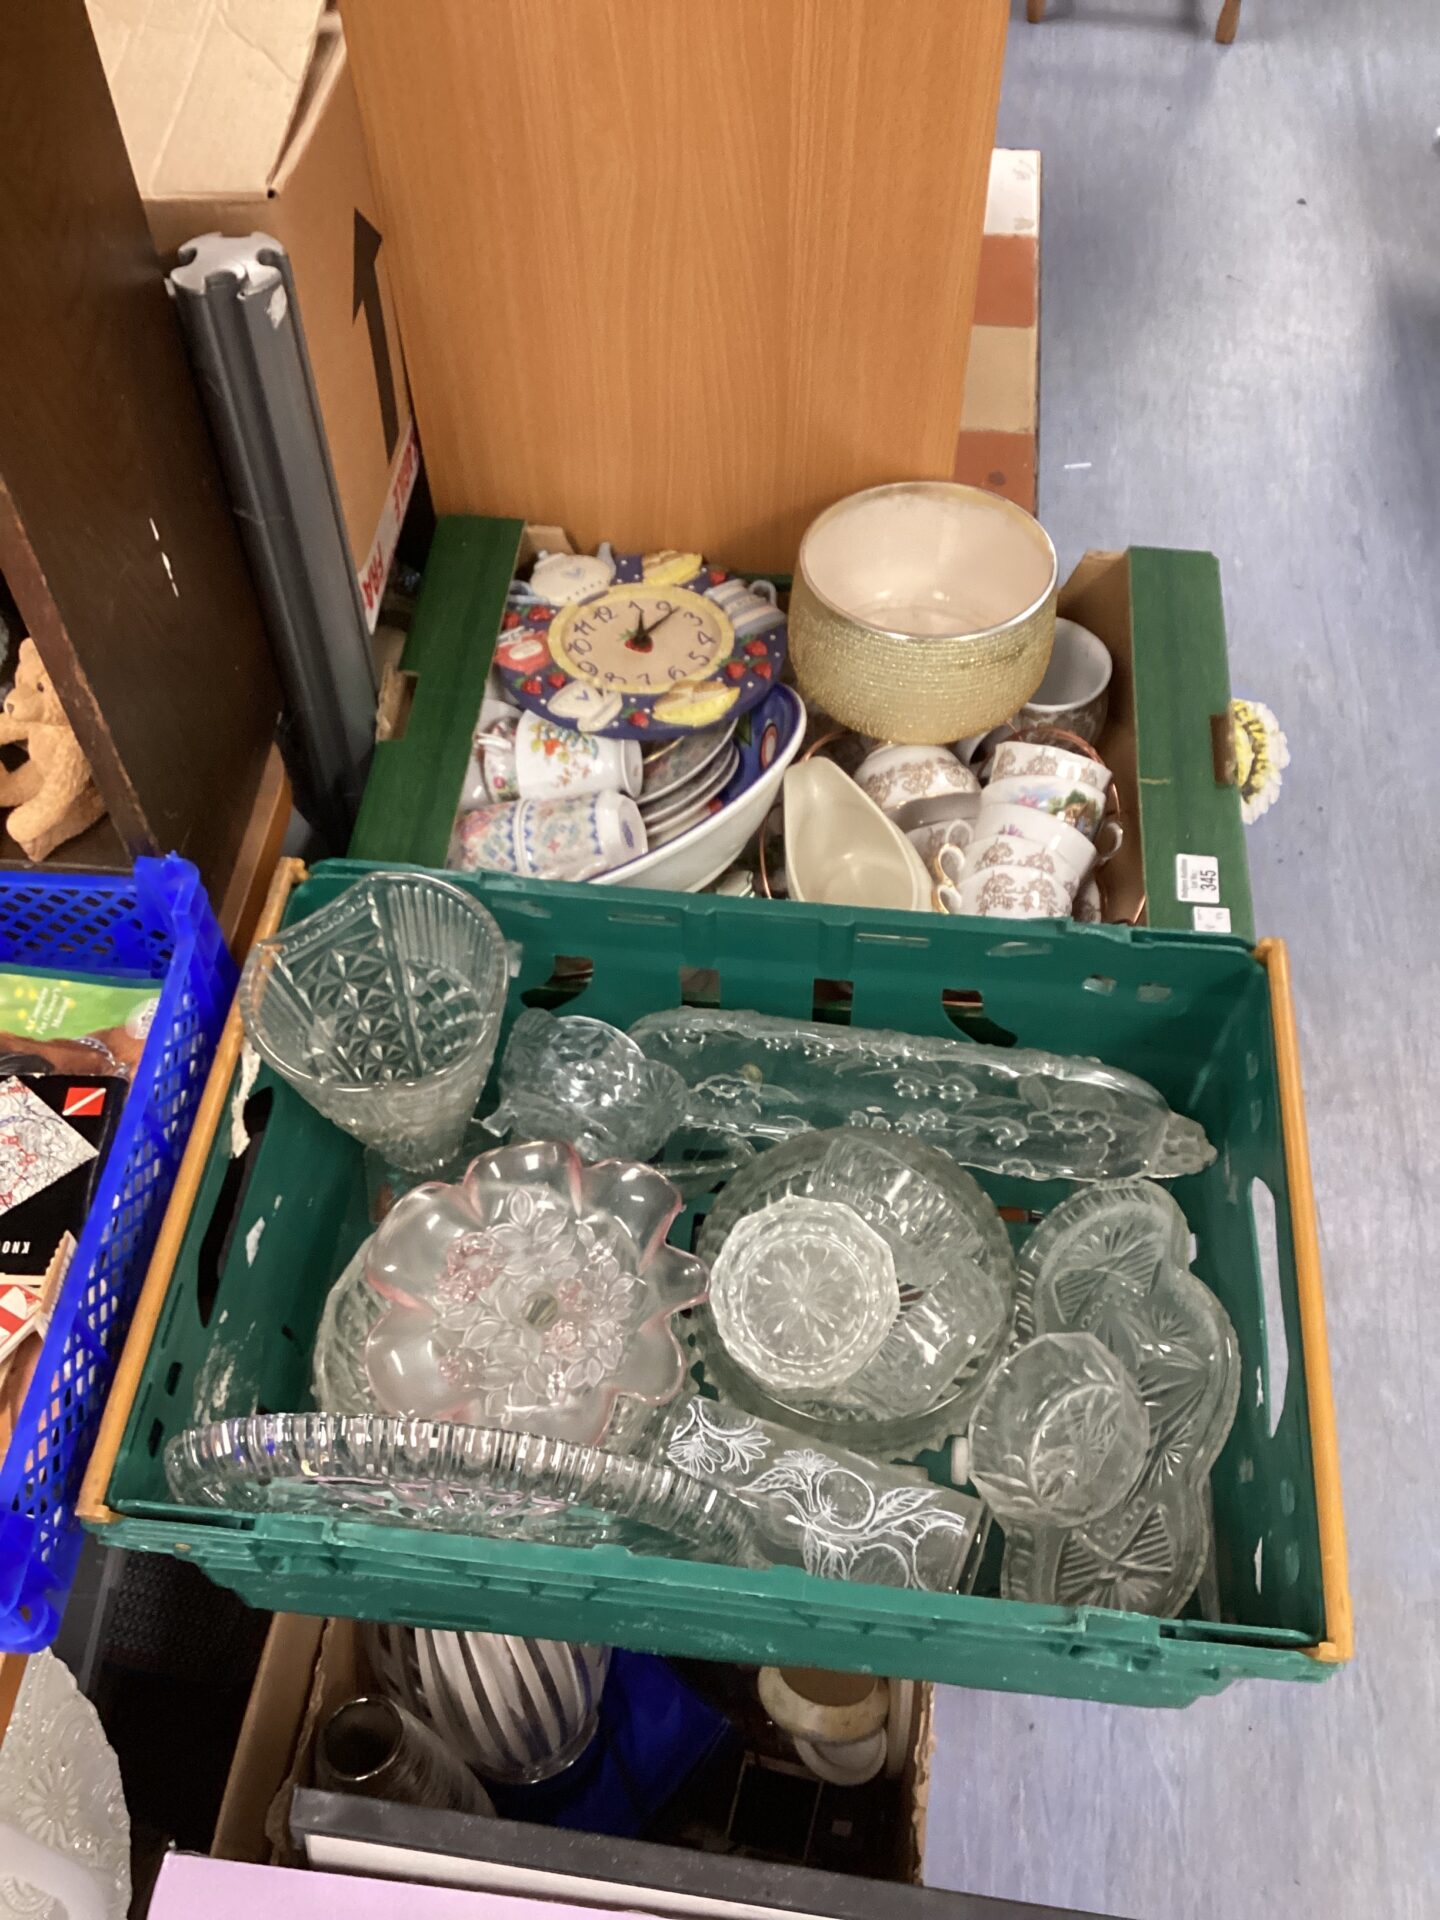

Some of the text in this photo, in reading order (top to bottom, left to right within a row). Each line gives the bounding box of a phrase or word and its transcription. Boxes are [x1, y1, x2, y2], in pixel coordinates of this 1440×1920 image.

[593, 606, 617, 623] 12
[683, 611, 703, 626] 3
[574, 620, 596, 636] 11
[697, 632, 716, 645] 4
[568, 639, 592, 655] 10
[688, 651, 710, 666] 5
[578, 661, 598, 676] 9
[668, 666, 686, 680] 6
[604, 672, 627, 684] 8
[637, 673, 651, 685] 7
[1200, 870, 1217, 891] 345
[0, 1241, 31, 1255] KNO
